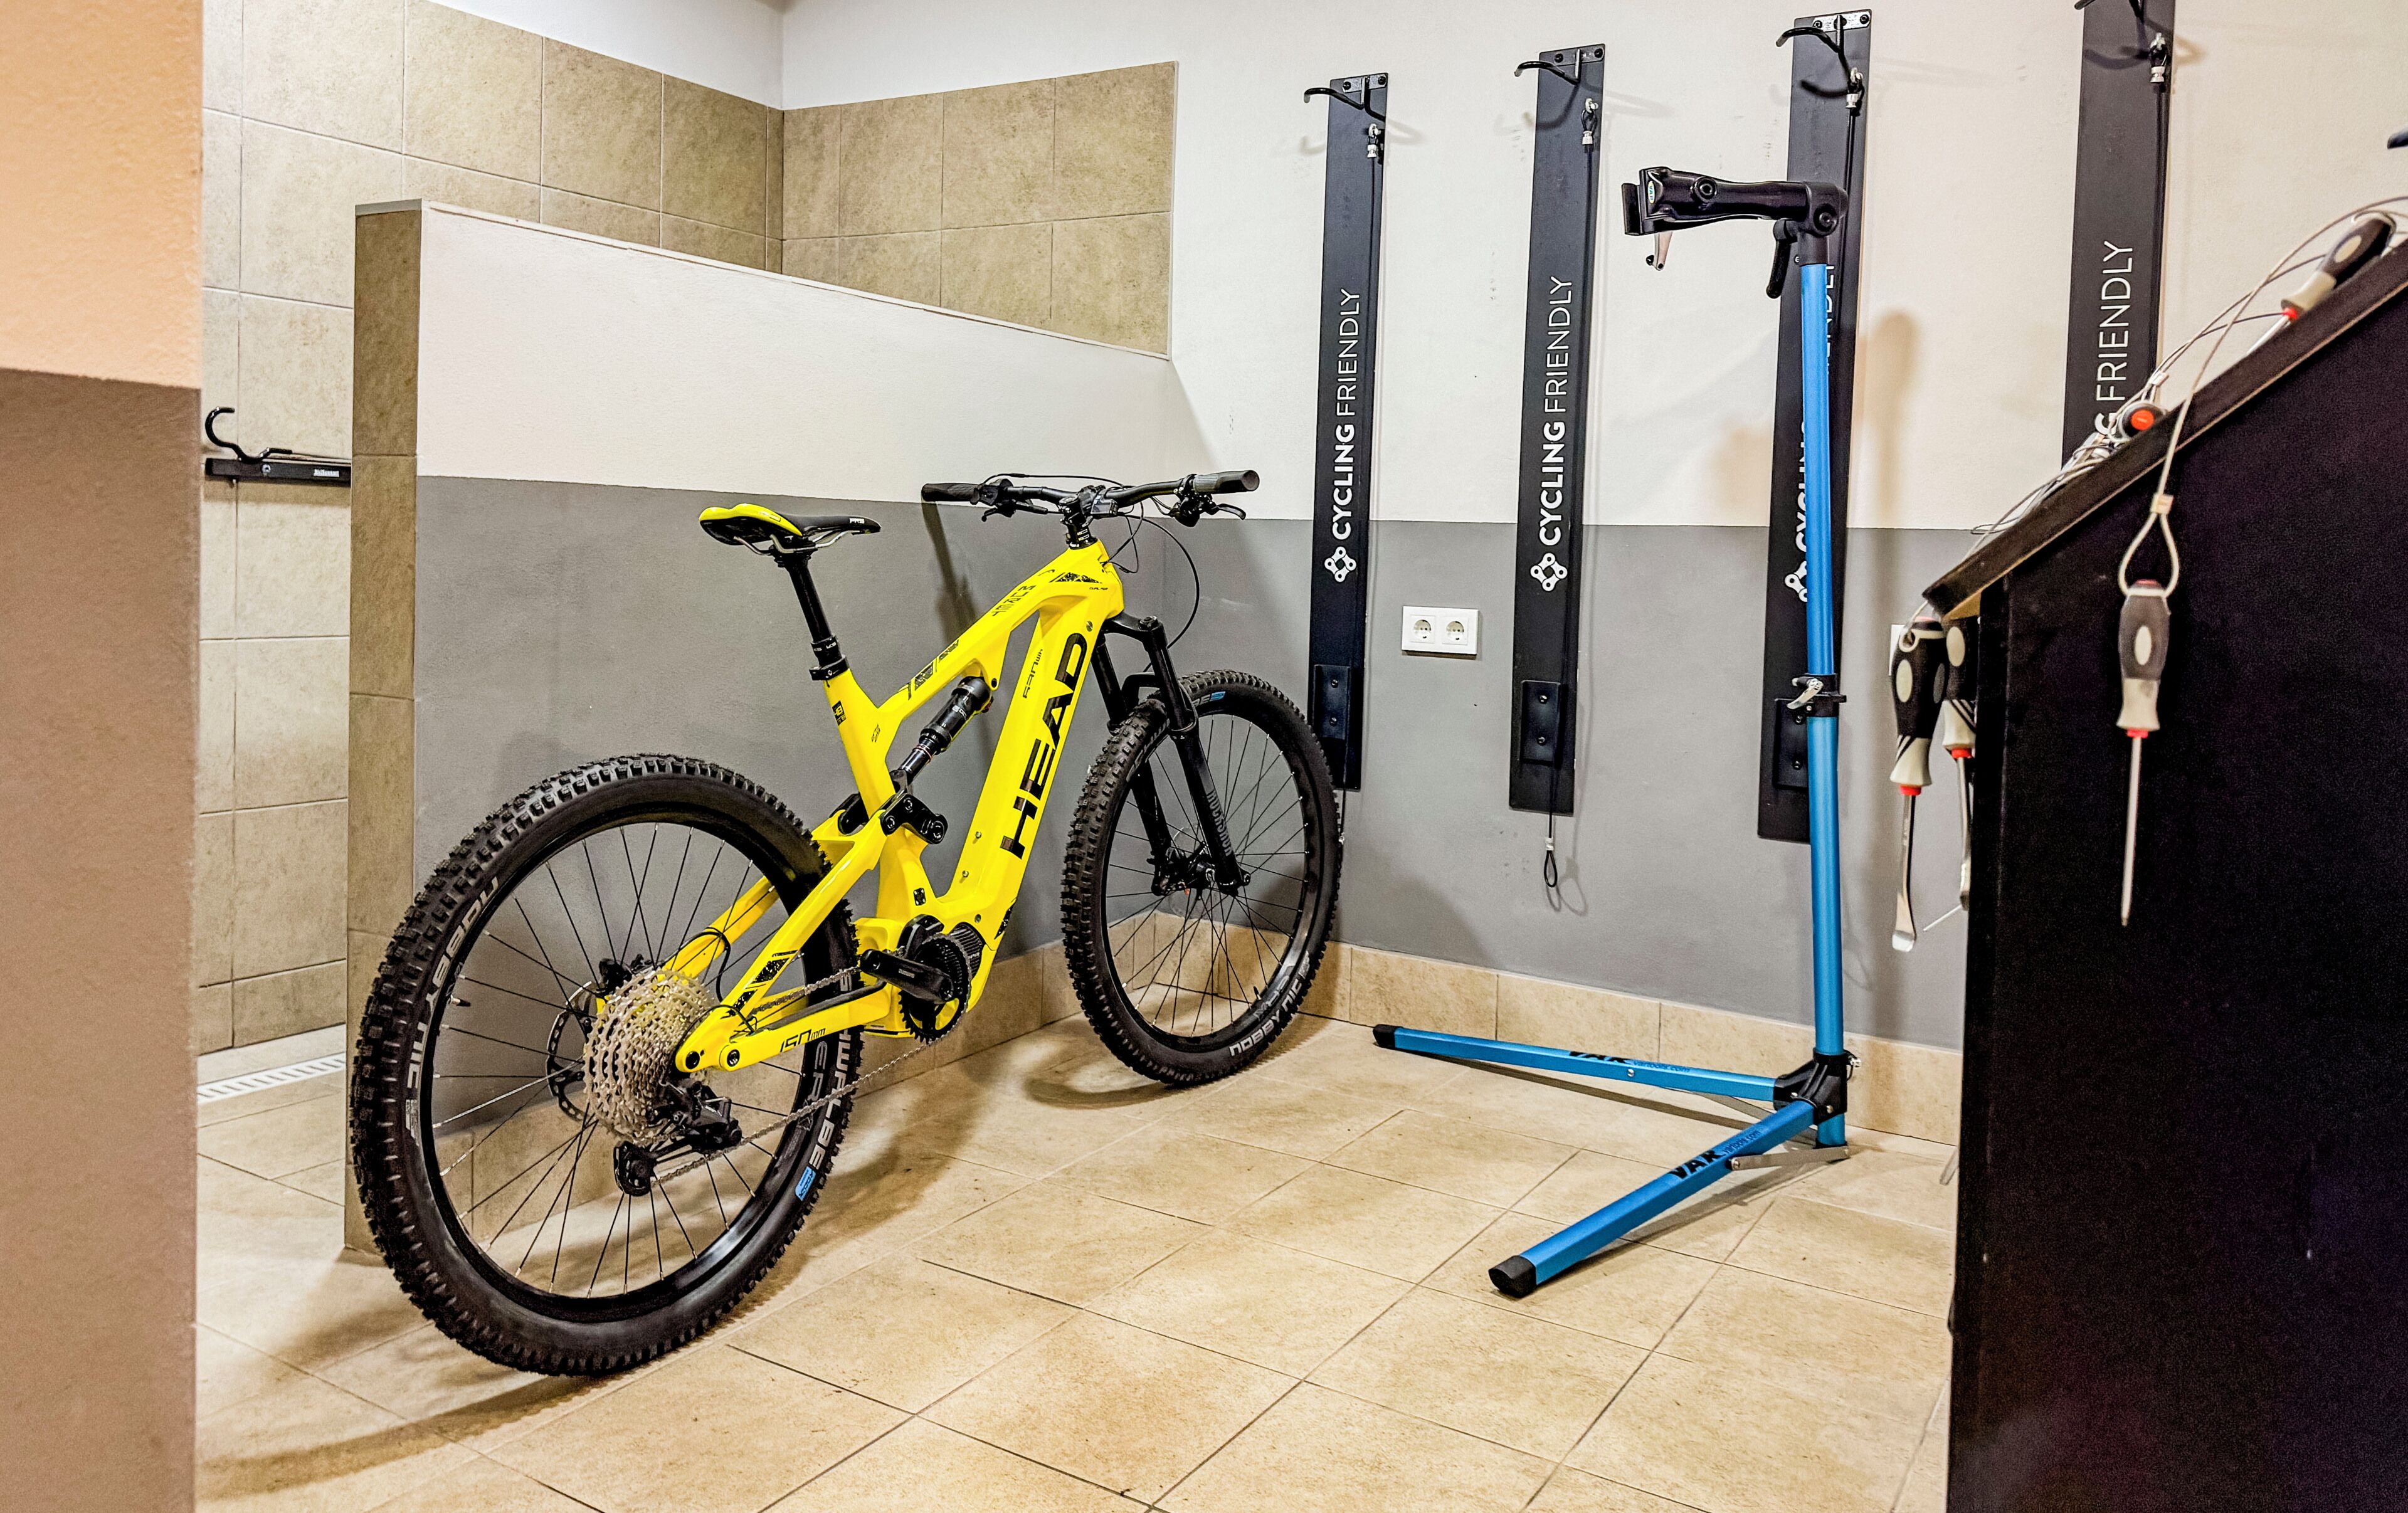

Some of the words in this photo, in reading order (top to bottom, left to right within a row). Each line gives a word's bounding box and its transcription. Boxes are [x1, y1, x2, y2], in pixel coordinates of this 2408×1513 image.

[1336, 288, 1360, 416] FRIENDLY
[1545, 276, 1572, 413] FRIENDLY
[2096, 241, 2133, 401] FRIENDLY
[1332, 424, 1355, 540] CYCLING
[1539, 421, 1566, 546] CYCLING
[1000, 633, 1087, 860] HEAD
[1228, 1010, 1280, 1057] NOBBY
[1281, 978, 1302, 1012] NIC
